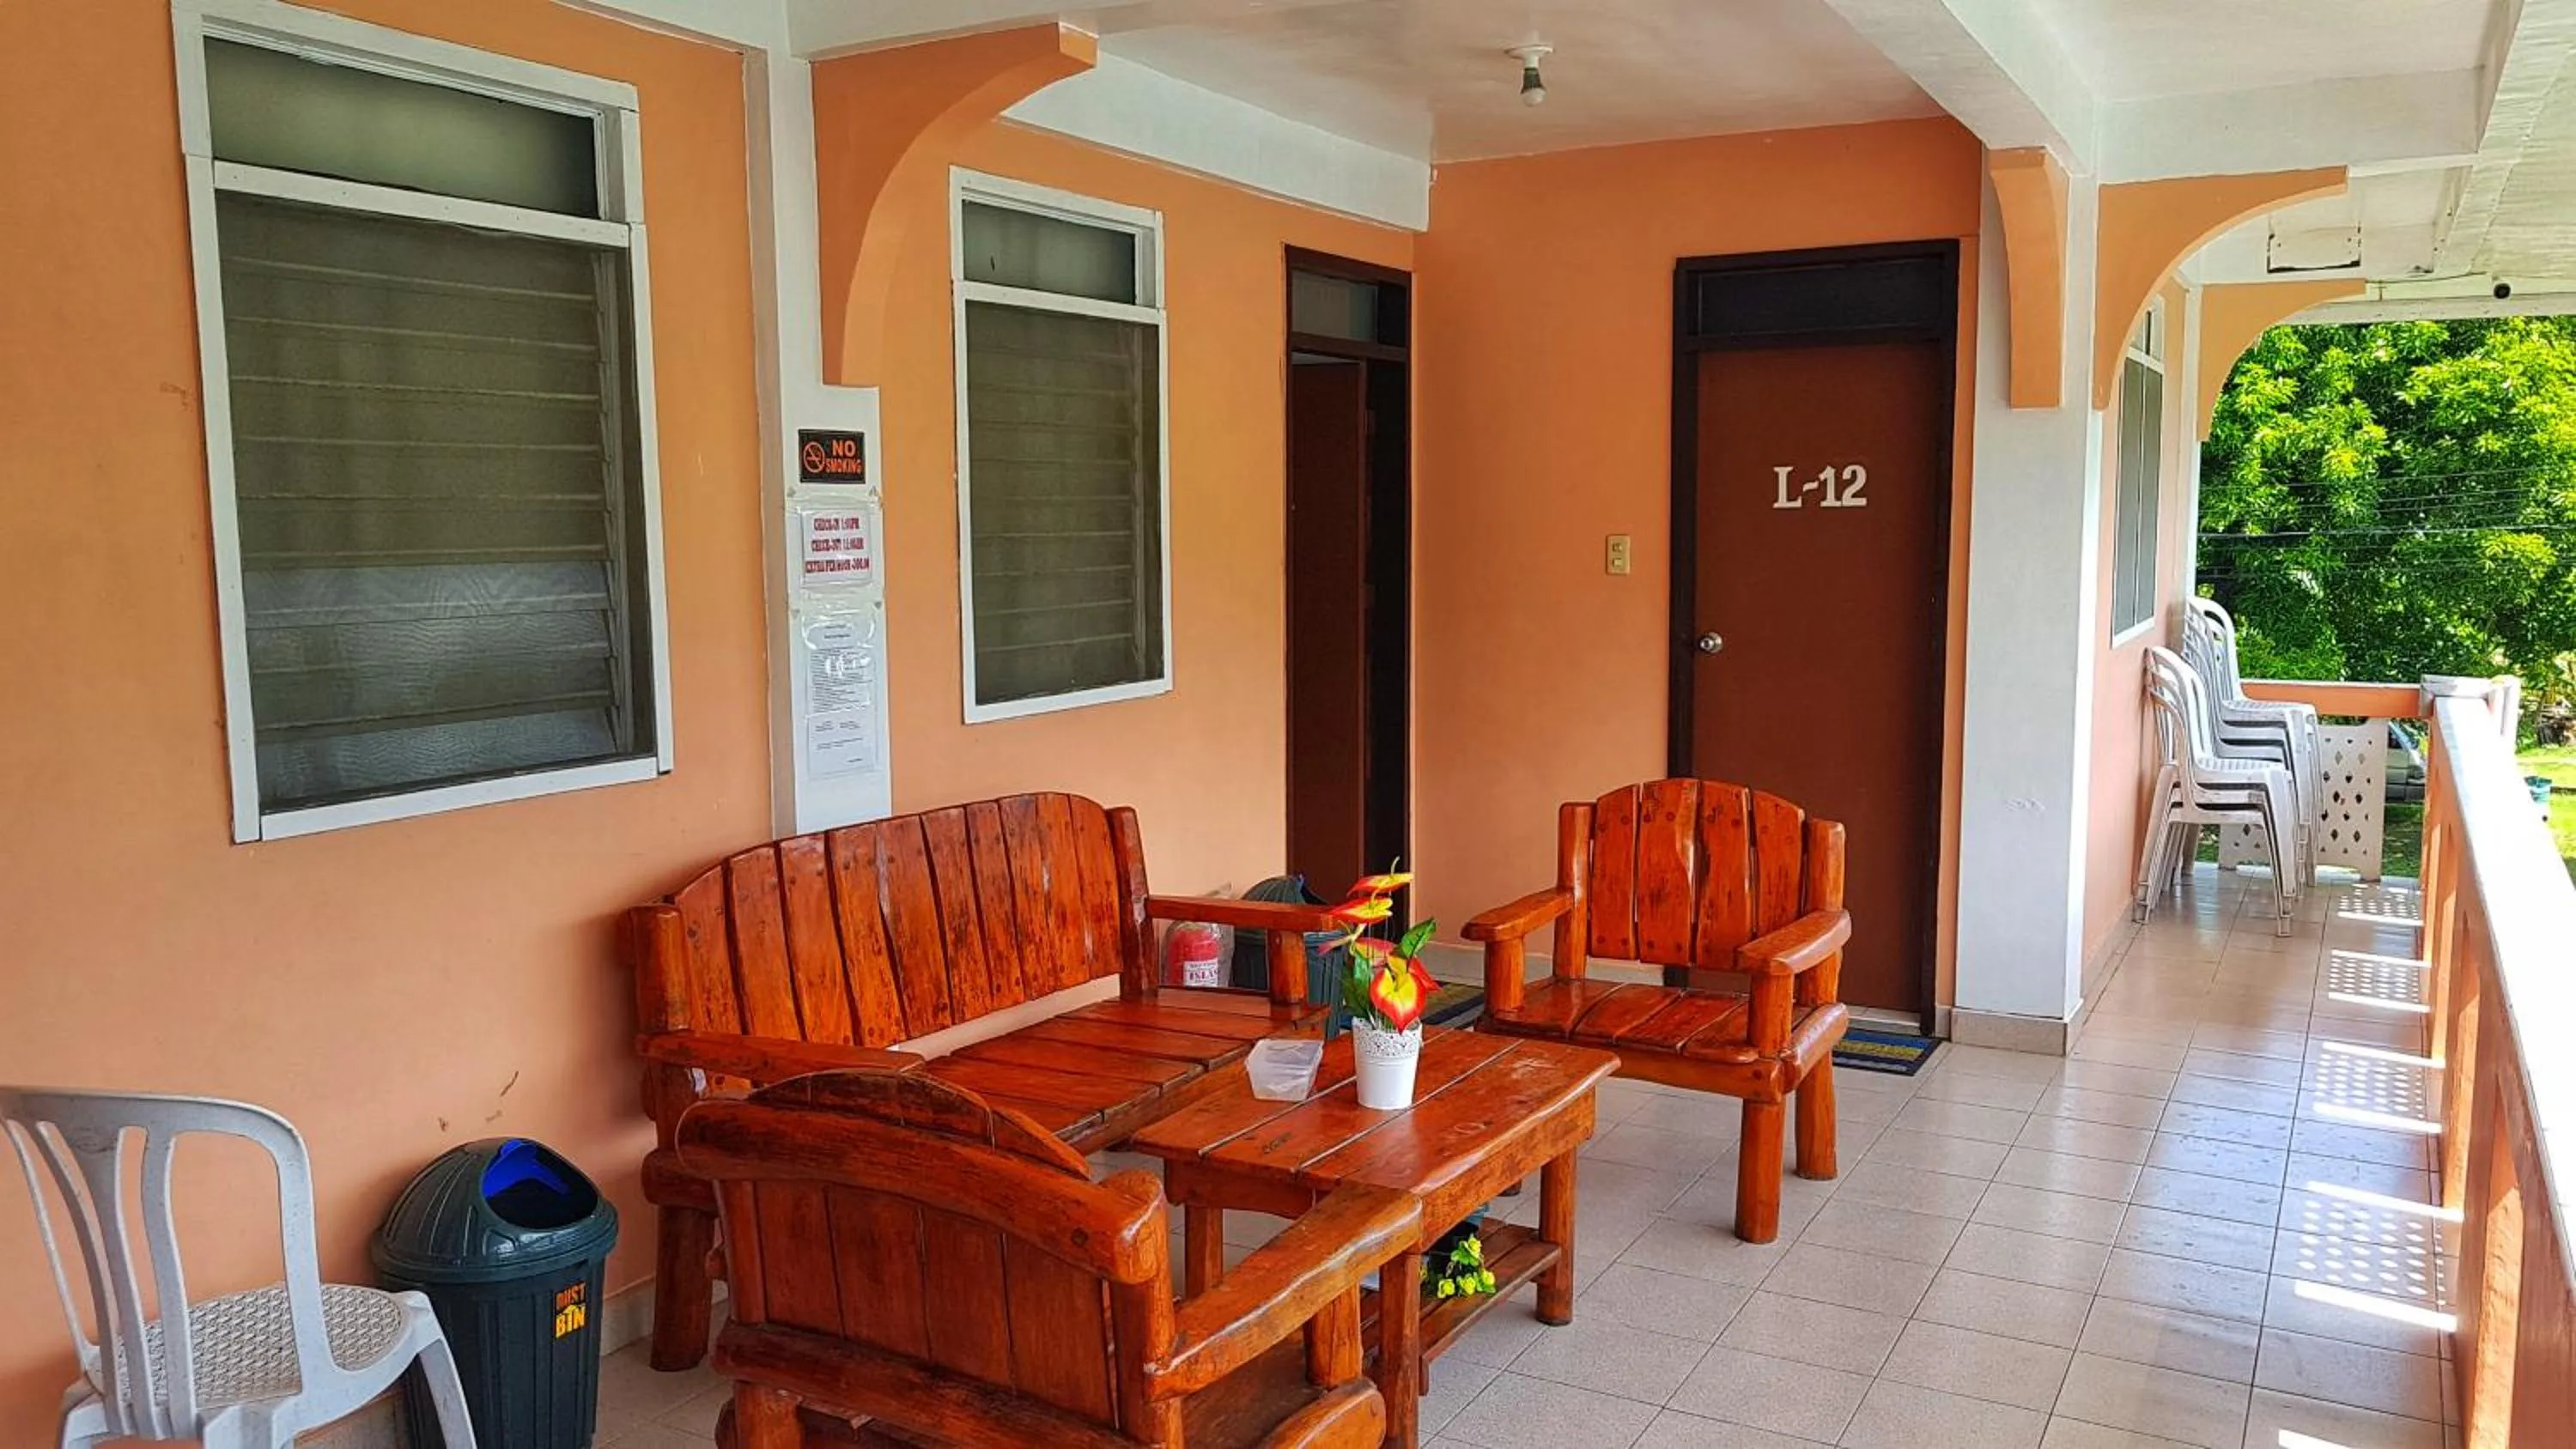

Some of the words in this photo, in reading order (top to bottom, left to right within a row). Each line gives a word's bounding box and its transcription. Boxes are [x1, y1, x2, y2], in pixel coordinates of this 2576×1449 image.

[832, 440, 856, 457] NO
[825, 458, 862, 474] SMOKING
[1773, 464, 1868, 508] L-12
[556, 1280, 586, 1310] DUST
[556, 1303, 586, 1338] BIN
